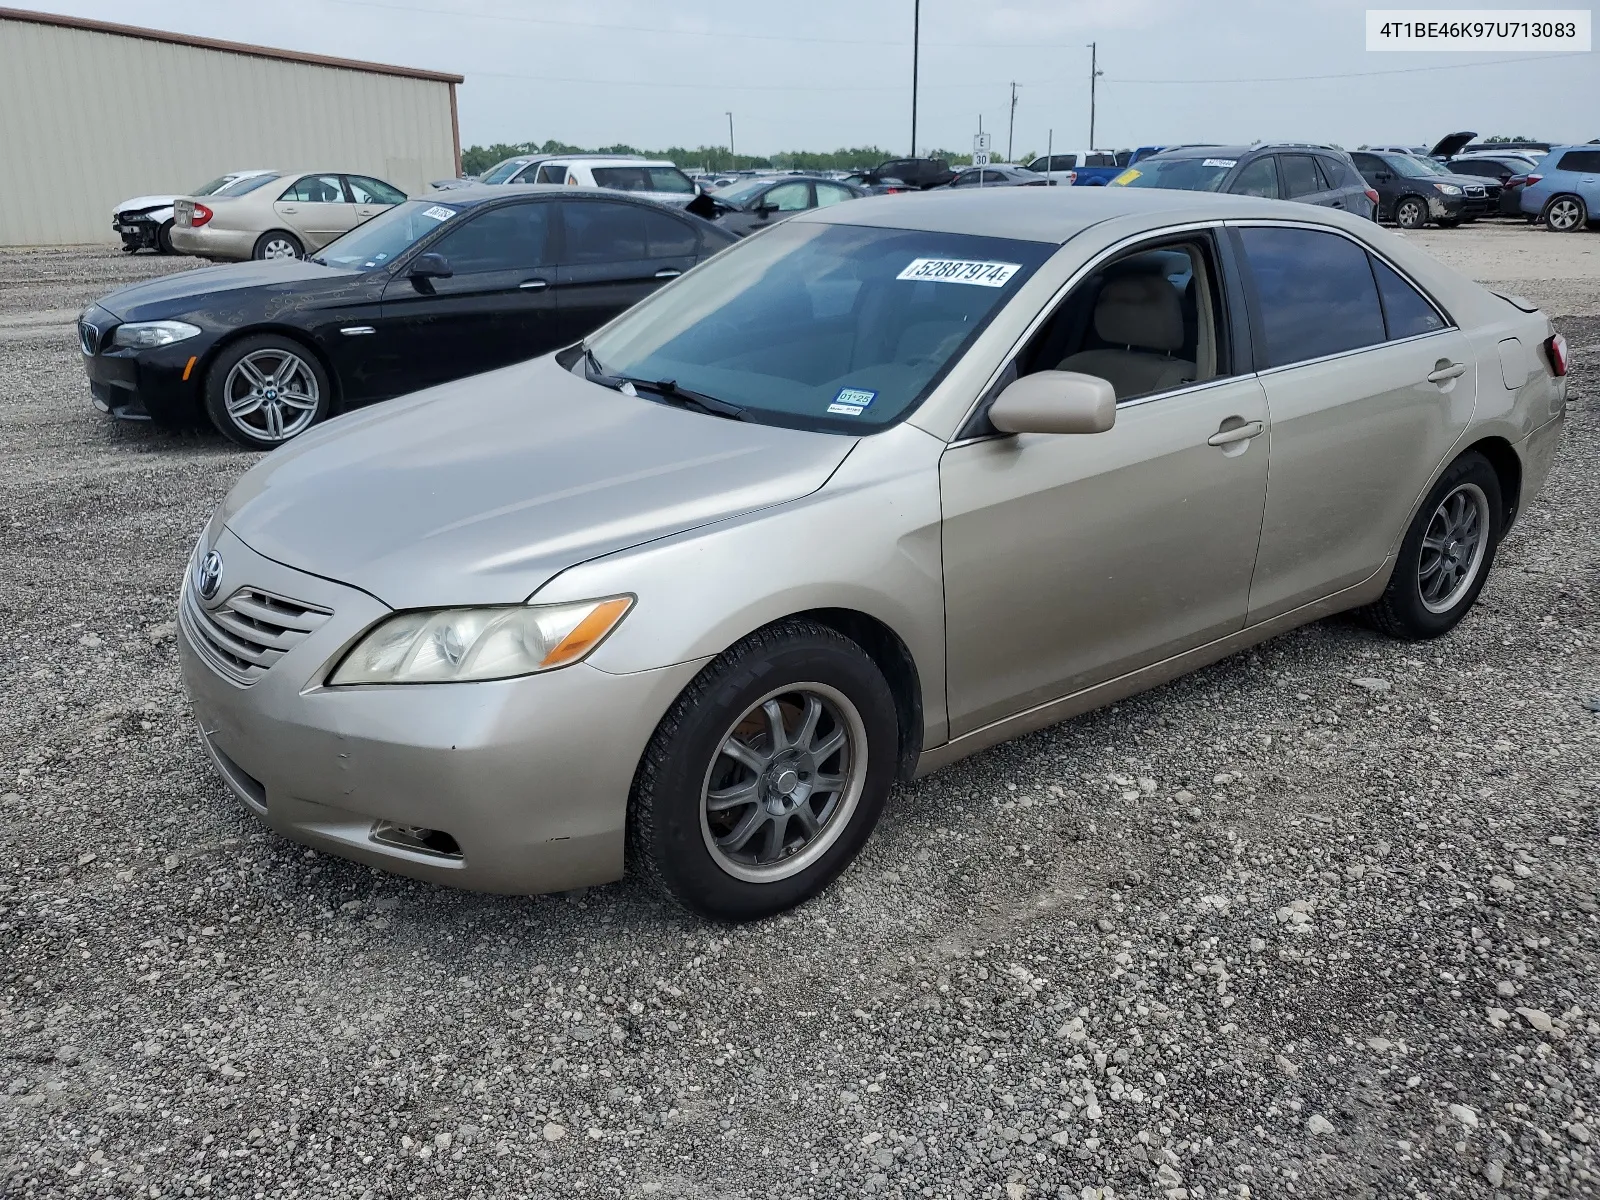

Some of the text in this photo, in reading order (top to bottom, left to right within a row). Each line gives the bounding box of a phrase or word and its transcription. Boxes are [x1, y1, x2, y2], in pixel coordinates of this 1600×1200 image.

[980, 137, 984, 147] E
[976, 155, 987, 165] 30
[915, 261, 1004, 281] 52887974
